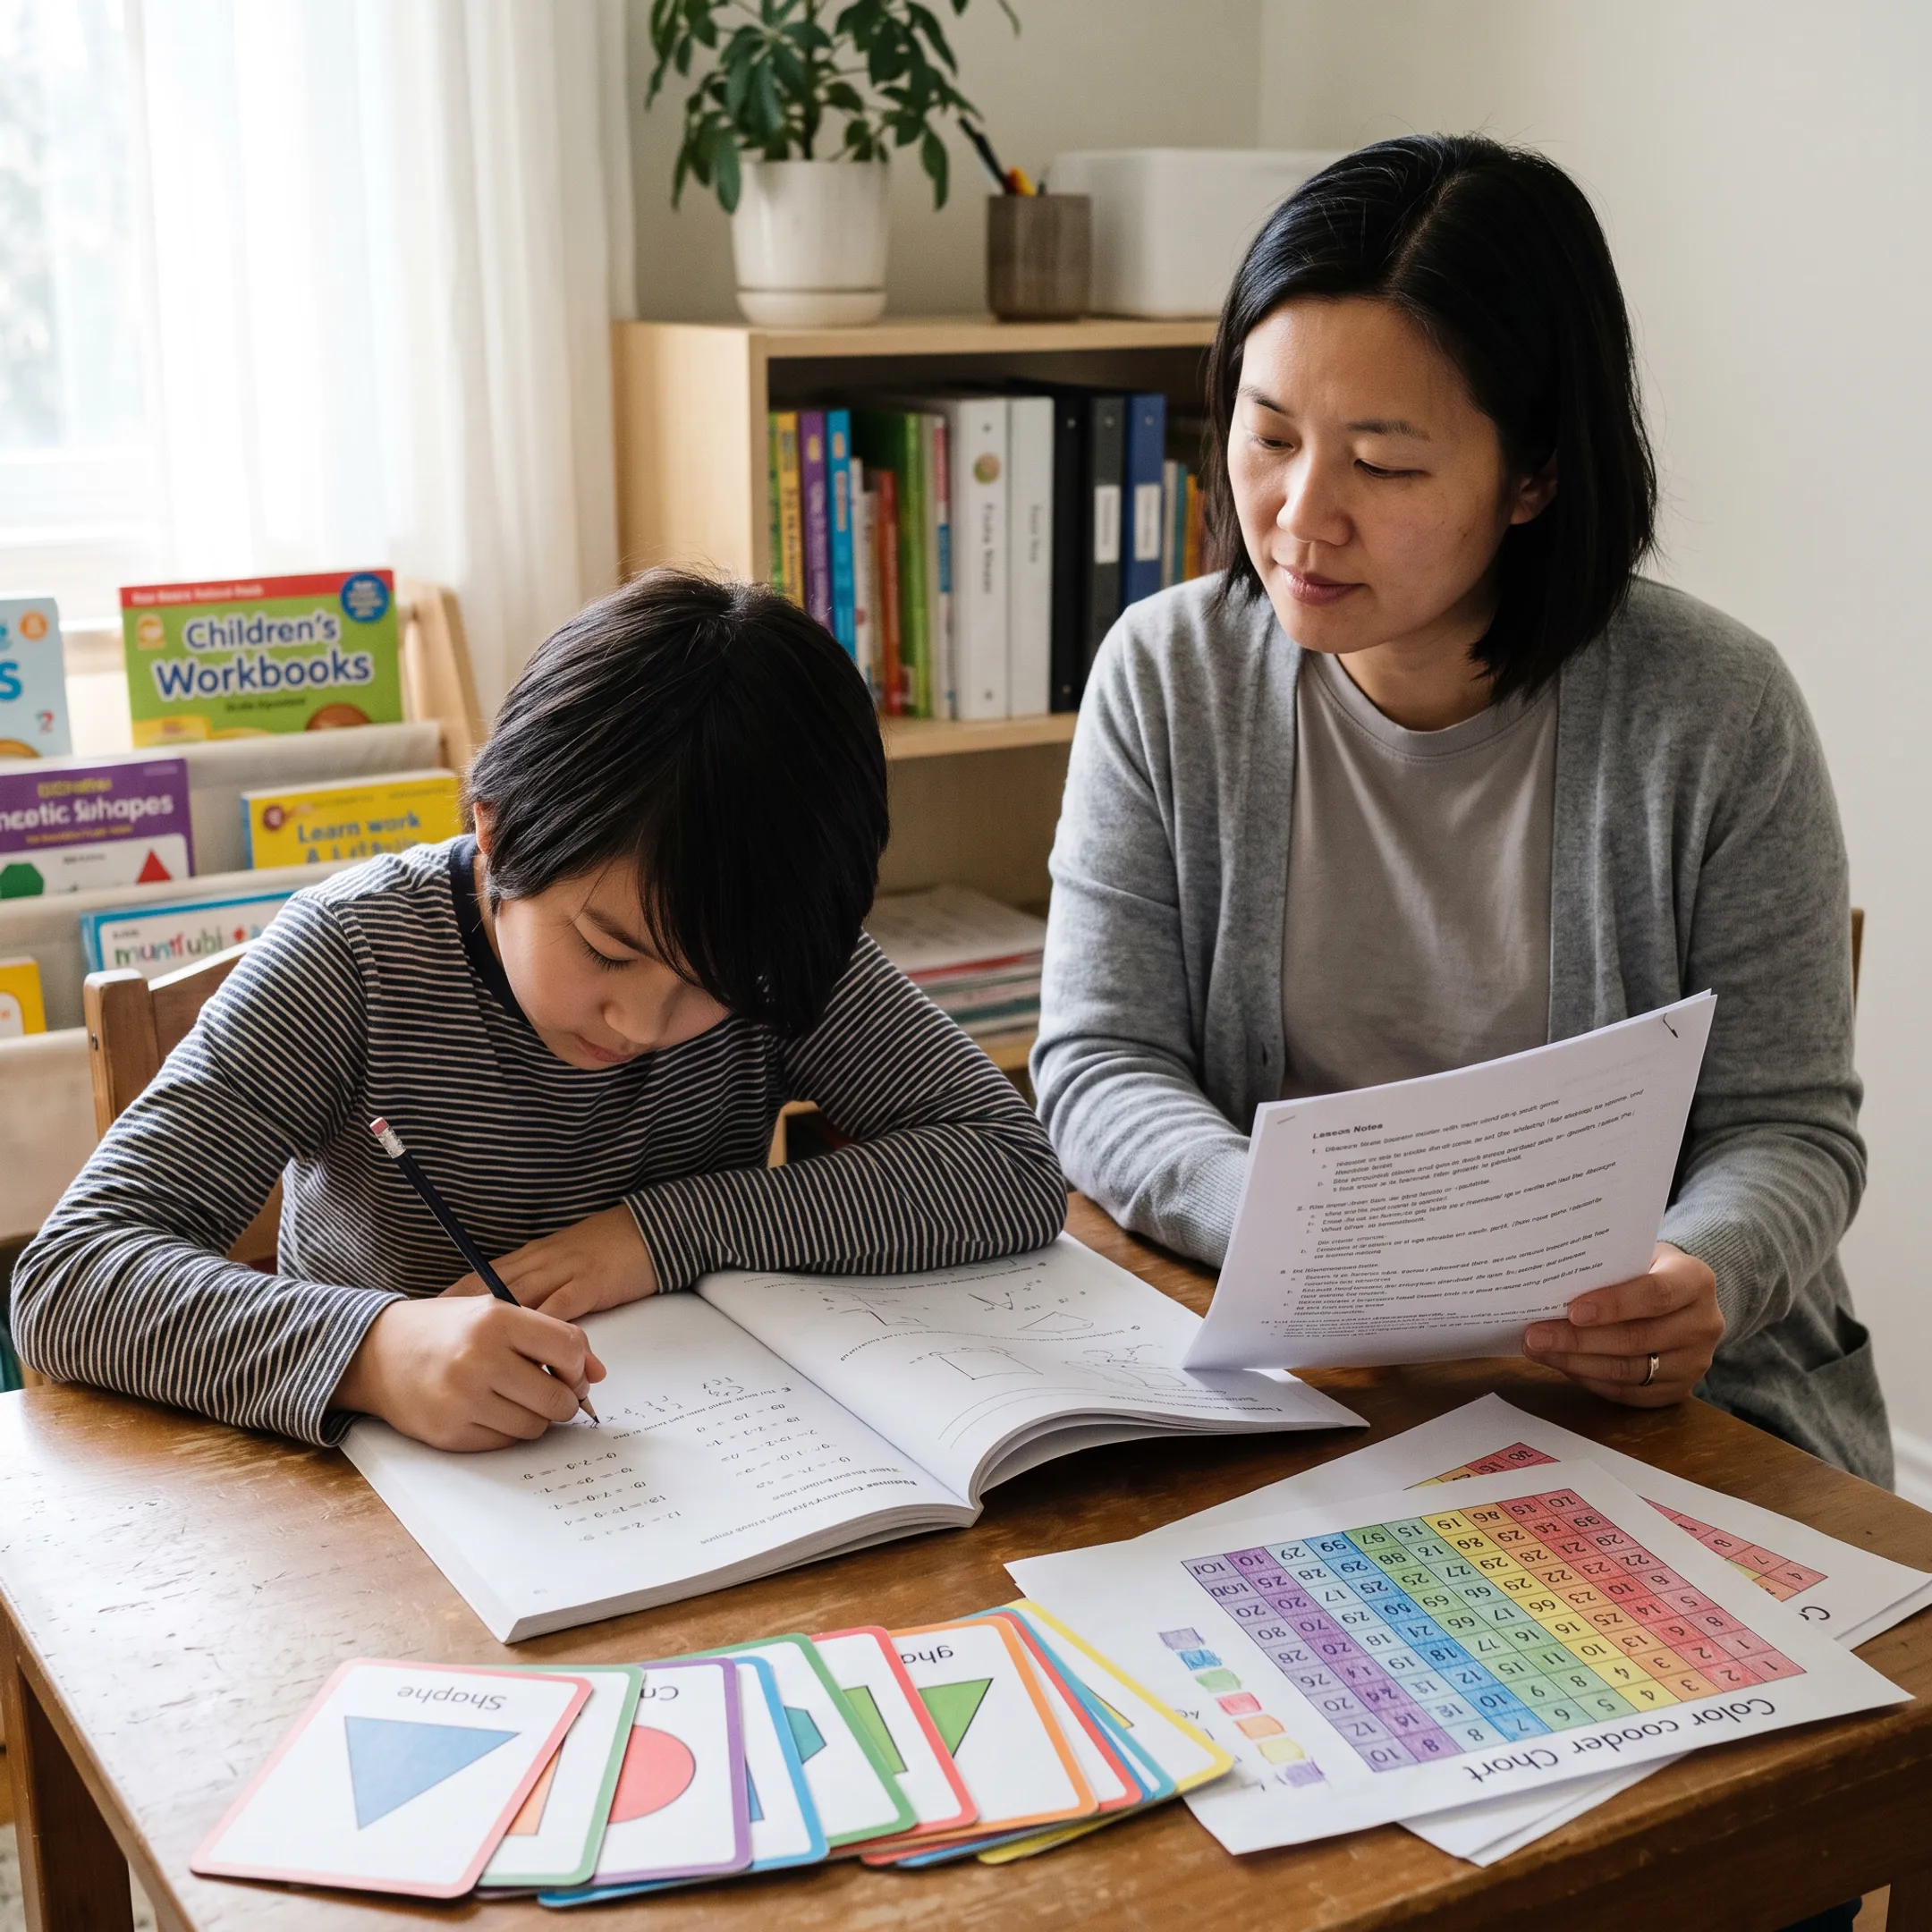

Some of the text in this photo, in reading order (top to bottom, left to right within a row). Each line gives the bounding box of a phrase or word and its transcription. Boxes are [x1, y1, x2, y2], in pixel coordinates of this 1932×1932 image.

[184, 613, 337, 649] Children's
[155, 648, 371, 698] Workbooks
[297, 821, 361, 843] Learn
[1353, 1123, 1384, 1133] Notes
[1280, 1546, 1306, 1560] 29
[1557, 1540, 1587, 1555] 21
[1237, 1554, 1265, 1566] 10
[1339, 1559, 1368, 1572] 29
[1479, 1555, 1509, 1570] 29
[1619, 1553, 1650, 1566] 22
[1445, 1564, 1471, 1578] 27
[1580, 1560, 1611, 1575] 23
[1256, 1574, 1287, 1589] 25
[1400, 1572, 1428, 1586] 25
[1540, 1568, 1573, 1583] 22
[1276, 1596, 1307, 1609] 20
[1324, 1589, 1347, 1602] 17
[1421, 1594, 1450, 1607] 69
[1567, 1590, 1597, 1604] 23
[1679, 1595, 1699, 1607] 5
[1234, 1604, 1267, 1618] 20
[1528, 1598, 1556, 1613] 66
[1634, 1603, 1662, 1616] 14
[1340, 1610, 1370, 1623] 29
[1493, 1606, 1515, 1621] 17
[1592, 1612, 1623, 1626] 25
[1298, 1618, 1329, 1632] 70
[1554, 1621, 1580, 1634] 16
[1705, 1615, 1724, 1627] 8
[1513, 1628, 1540, 1642] 16
[1667, 1624, 1685, 1637] 6
[1321, 1640, 1352, 1656] 20
[1620, 1634, 1648, 1648] 13
[1735, 1639, 1750, 1650] 1
[1428, 1646, 1458, 1661] 18
[1580, 1642, 1606, 1657] 10
[1690, 1646, 1712, 1659] 2
[1387, 1656, 1415, 1669] 19
[1541, 1651, 1565, 1665] 11
[1651, 1657, 1671, 1669] 3
[1762, 1659, 1778, 1671] 1
[1497, 1661, 1525, 1674] 15
[1299, 1673, 1330, 1688] 26
[1456, 1669, 1482, 1684] 12
[1569, 1674, 1588, 1688] 8
[1719, 1668, 1741, 1682] 2
[1530, 1684, 1546, 1698] 9
[1679, 1678, 1699, 1691] 3
[397, 1686, 506, 1710] Shaphe
[1479, 1692, 1508, 1708] 10
[1639, 1689, 1655, 1701] 4
[1322, 1696, 1353, 1711] 20
[1596, 1698, 1616, 1712] 5
[1553, 1707, 1571, 1720] 6
[1516, 1716, 1531, 1733] 7
[1462, 1698, 1775, 1783] Color cooder Chort
[1466, 1727, 1485, 1741] 8
[1368, 1747, 1401, 1763] 10
